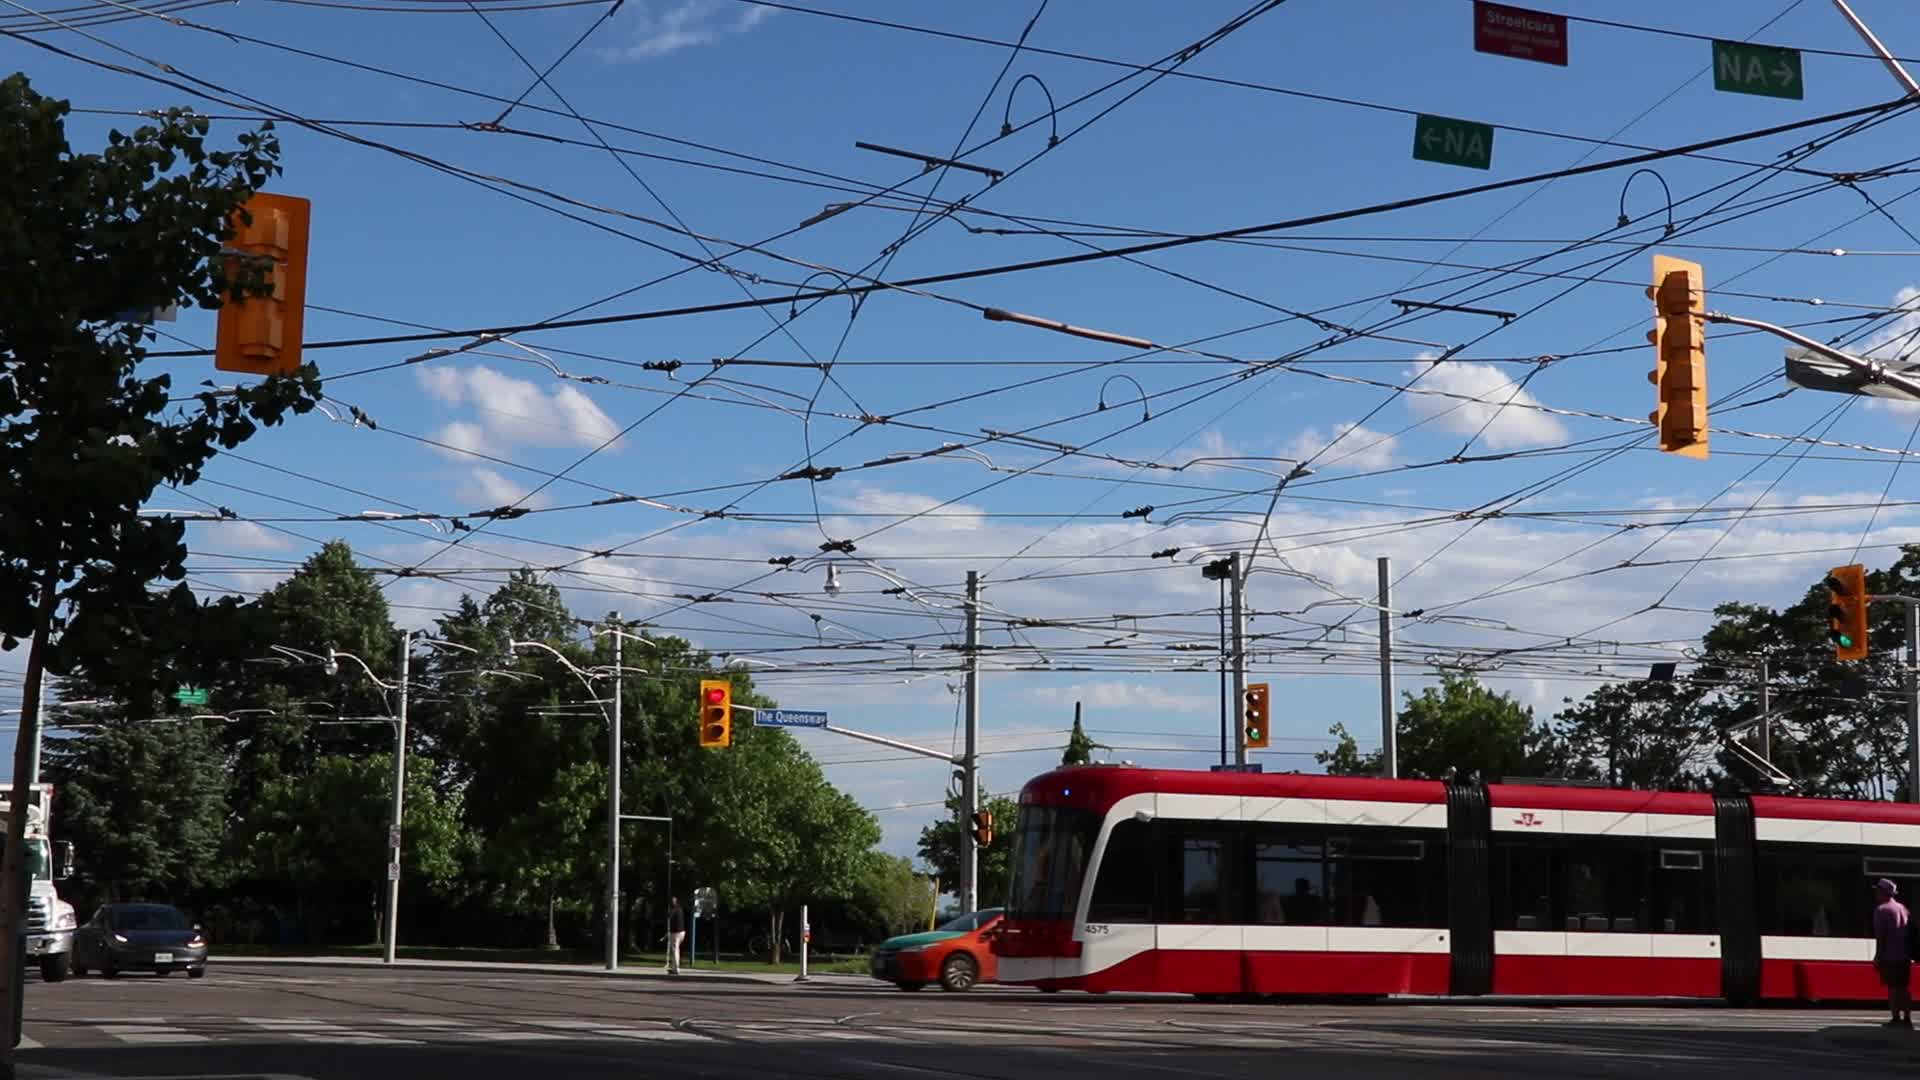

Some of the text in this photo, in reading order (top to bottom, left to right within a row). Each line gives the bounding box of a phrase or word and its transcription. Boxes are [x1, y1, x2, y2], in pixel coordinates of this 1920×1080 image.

[1719, 52, 1768, 88] NA
[1443, 126, 1486, 160] NA
[757, 710, 826, 727] The Queensway
[1085, 924, 1110, 934] 4575
